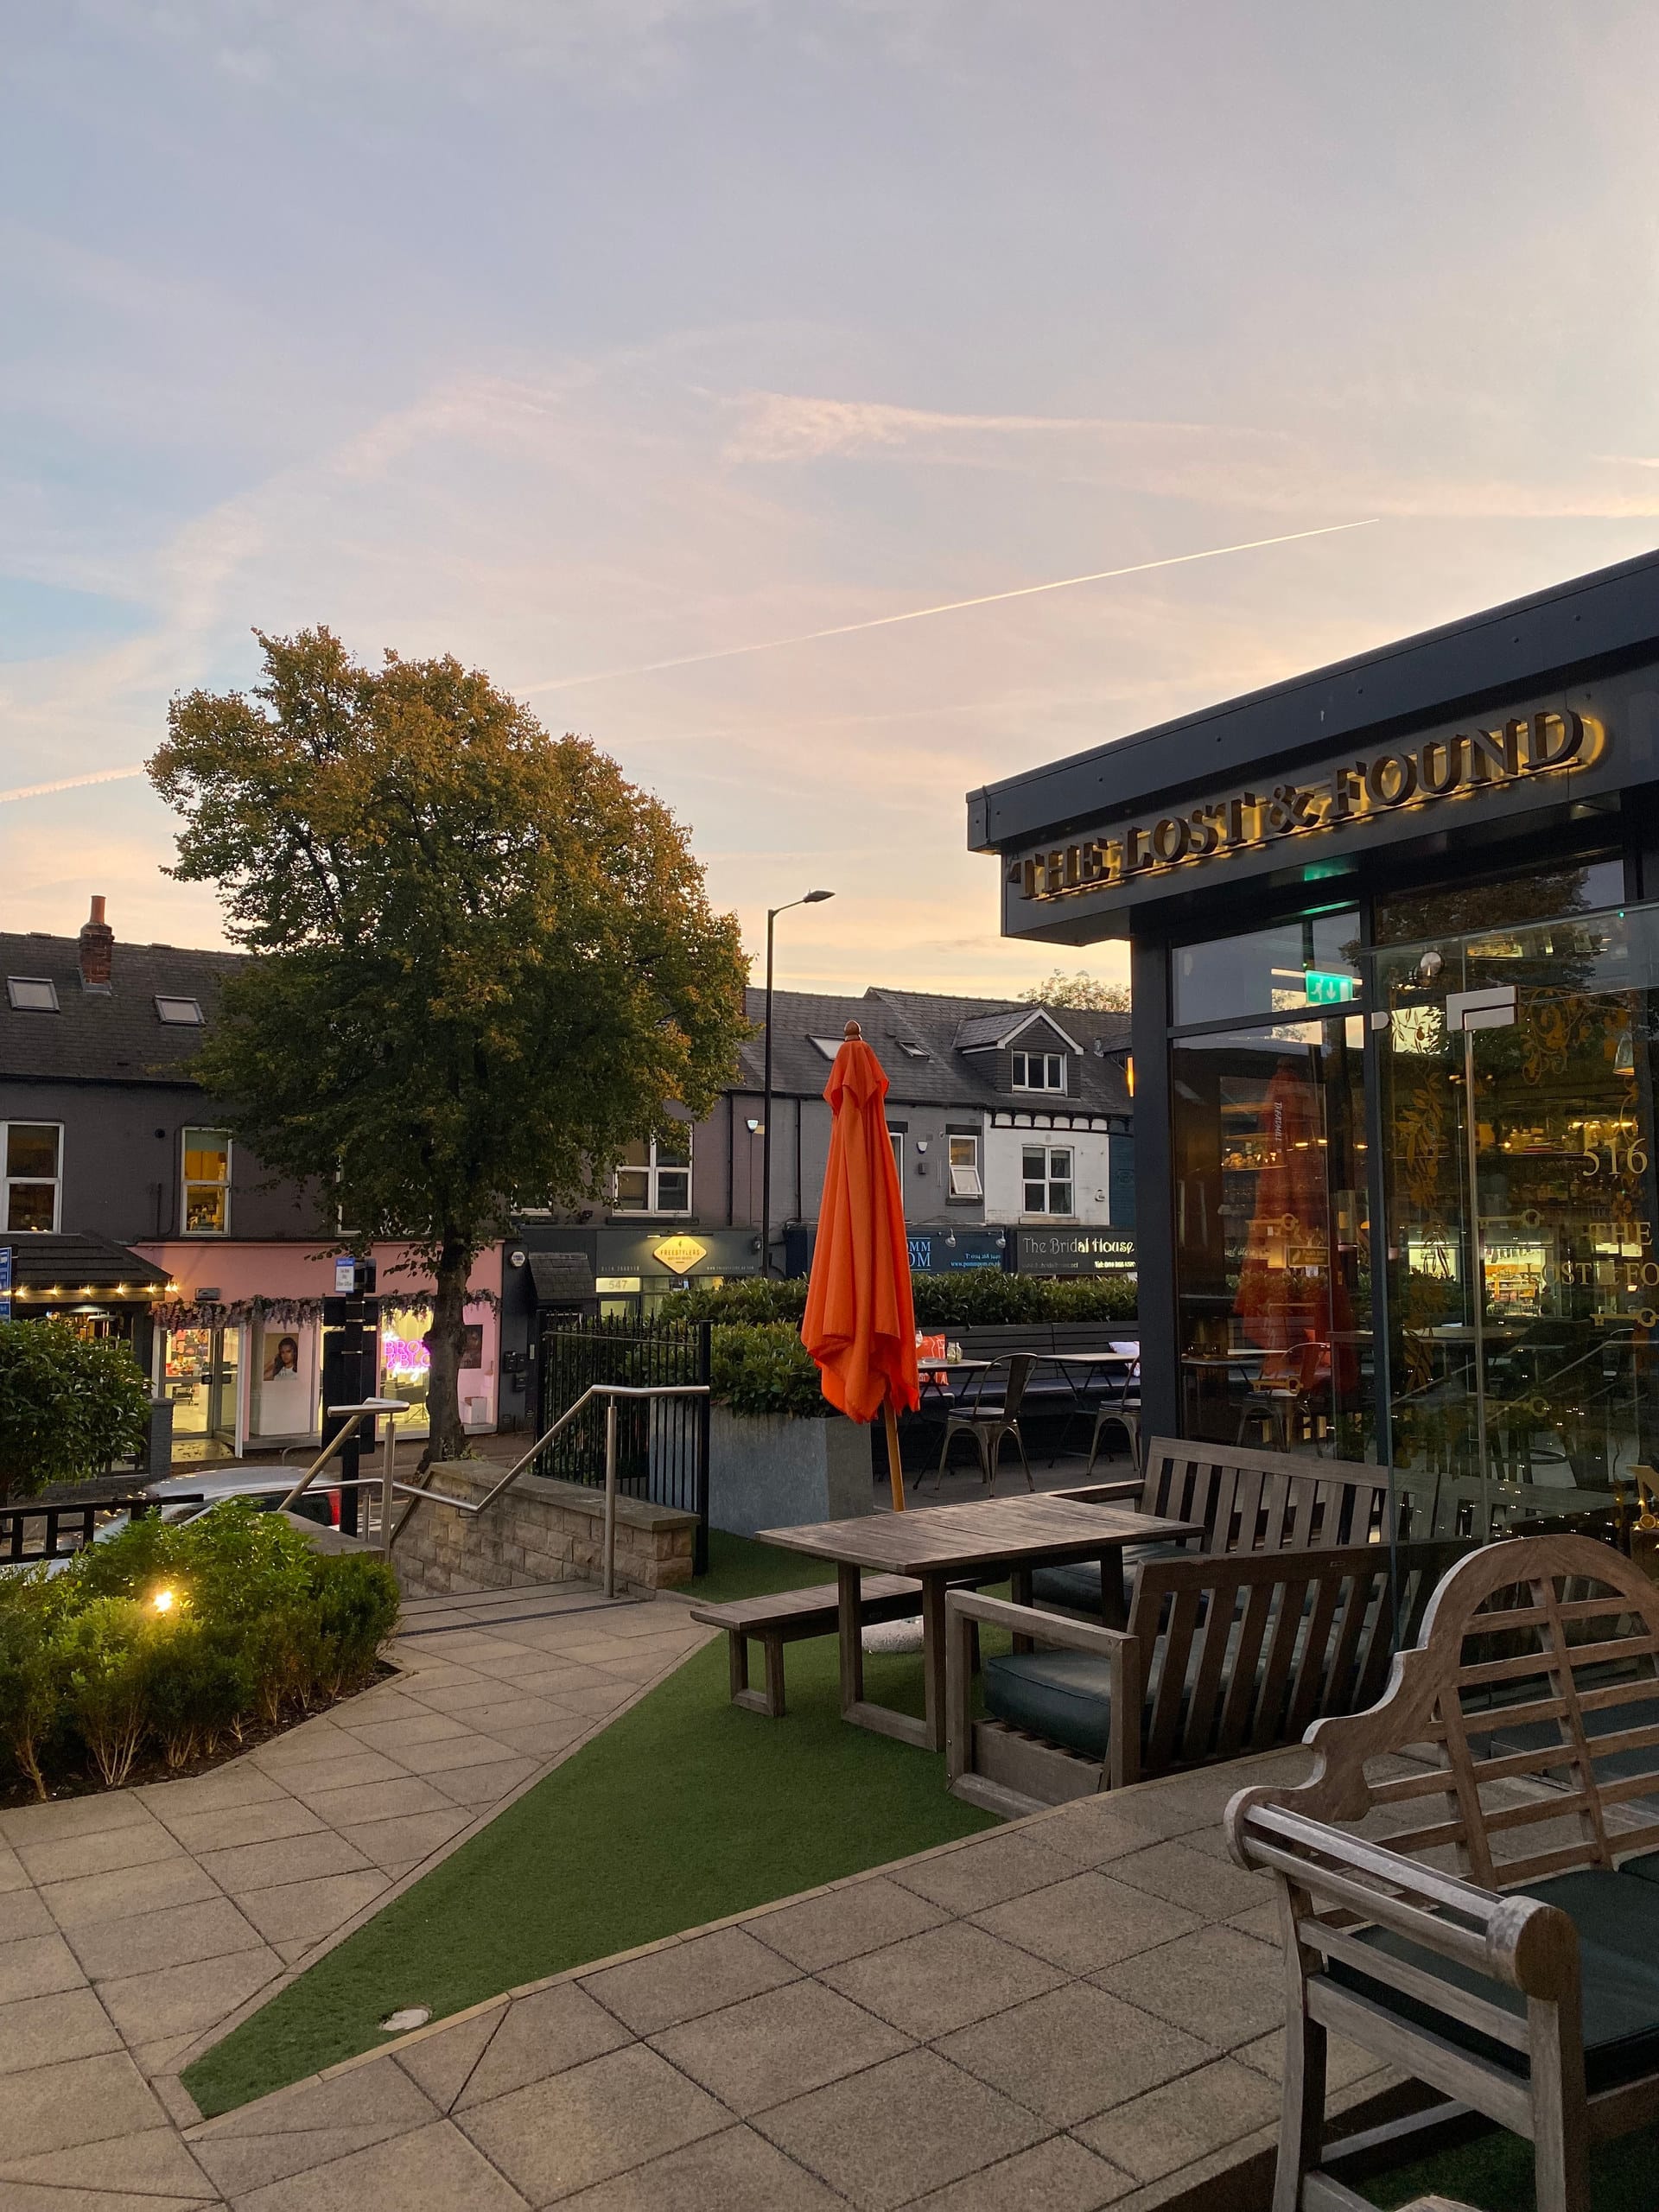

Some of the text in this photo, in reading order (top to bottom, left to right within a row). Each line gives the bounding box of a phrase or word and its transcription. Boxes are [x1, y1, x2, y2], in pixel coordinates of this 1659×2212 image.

[1006, 709, 1585, 899] THE LOST & FOUND
[1582, 1137, 1648, 1177] 516
[1022, 1236, 1135, 1255] The Bridal House
[607, 1280, 628, 1290] 547
[399, 1353, 430, 1367] BLO
